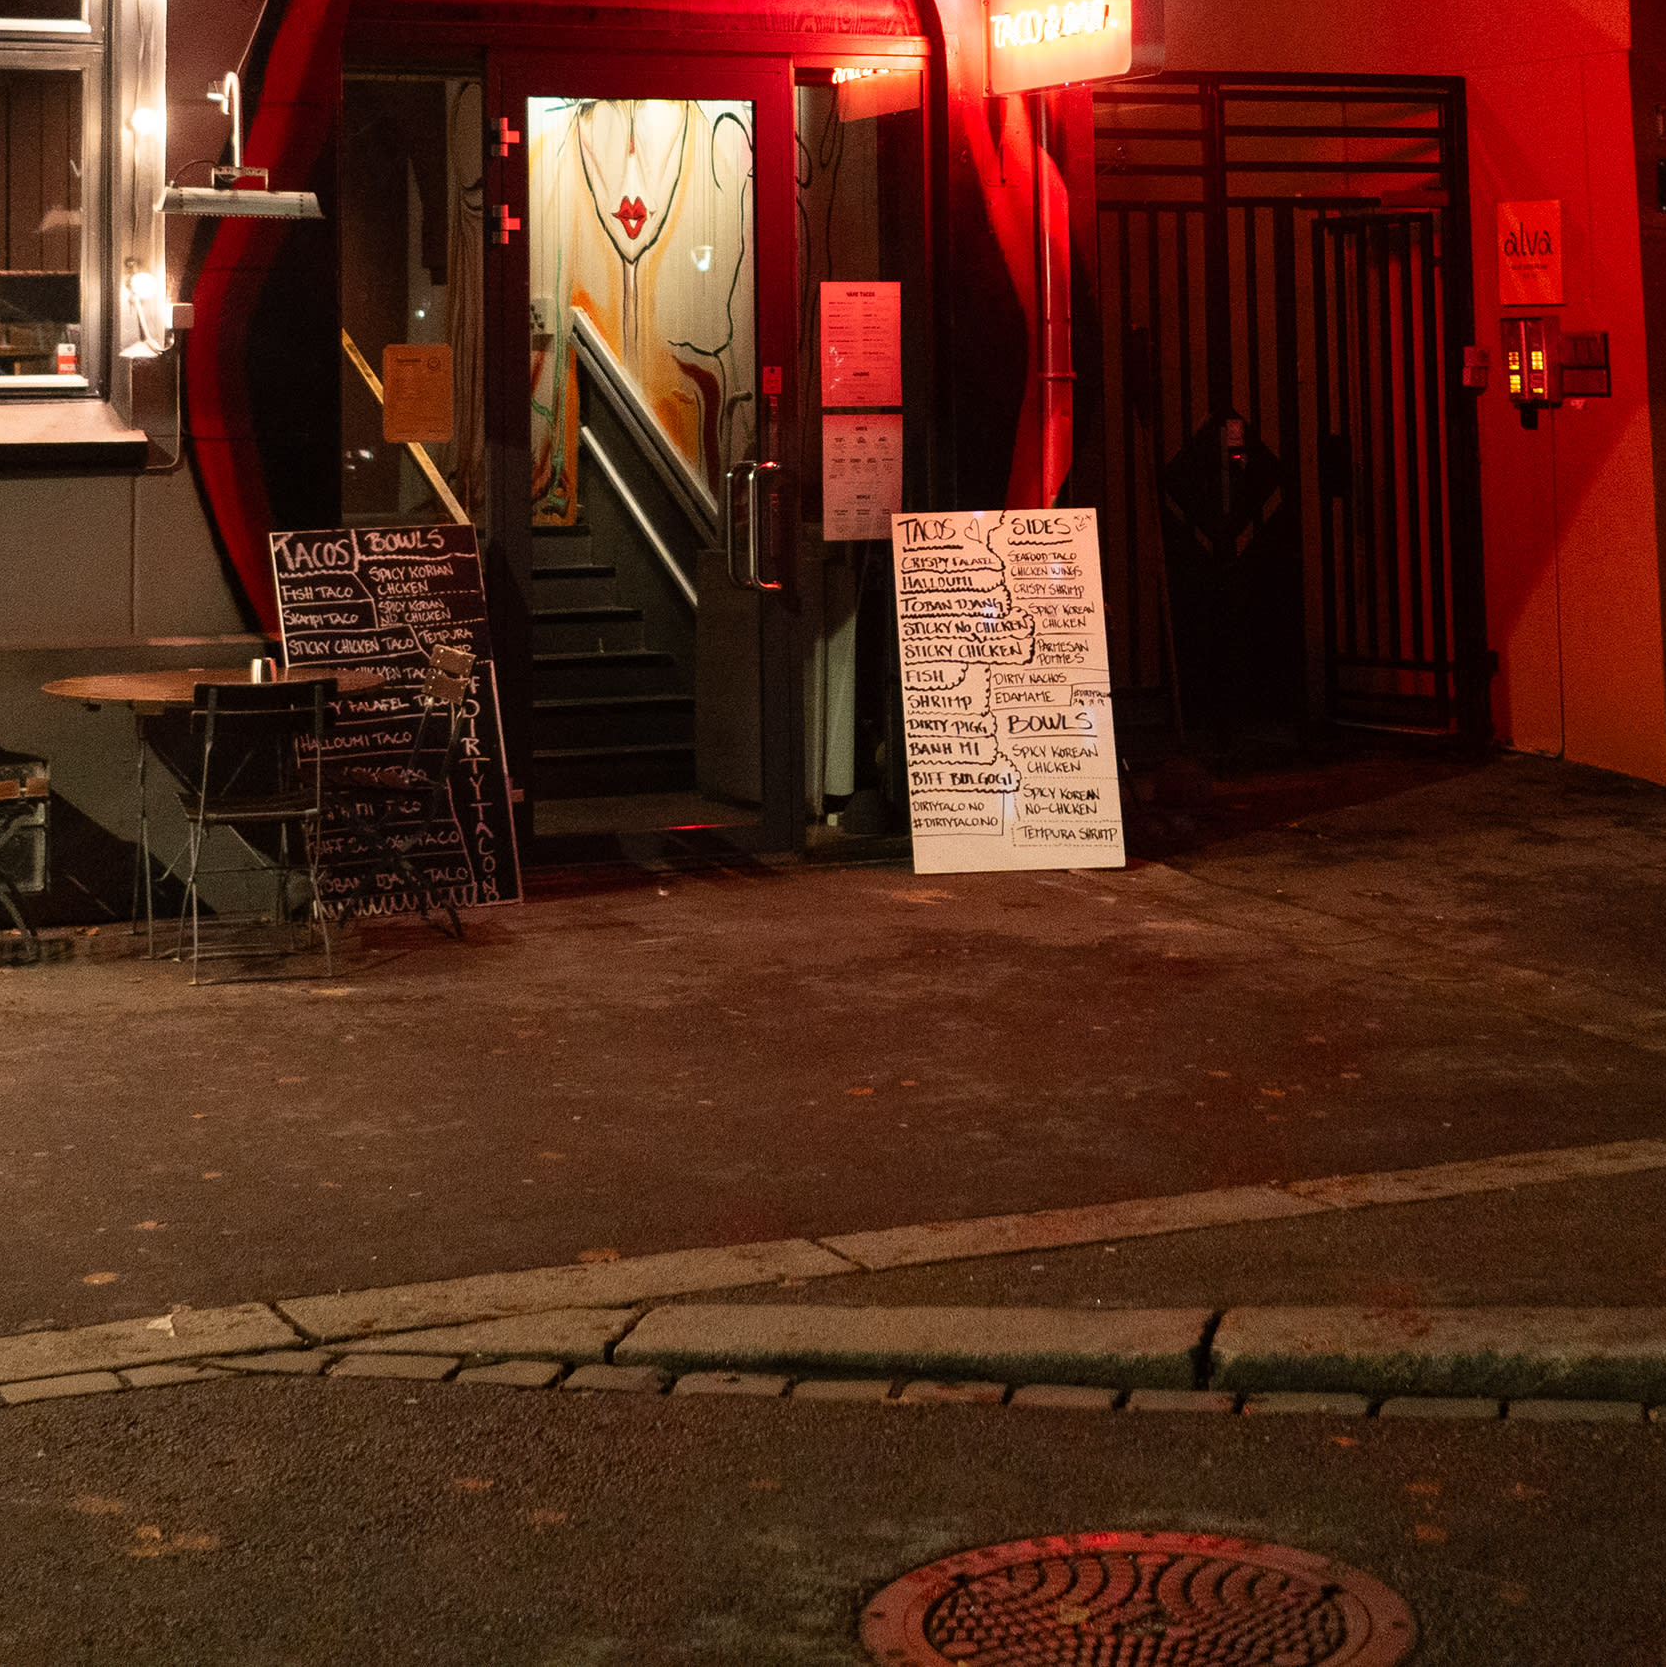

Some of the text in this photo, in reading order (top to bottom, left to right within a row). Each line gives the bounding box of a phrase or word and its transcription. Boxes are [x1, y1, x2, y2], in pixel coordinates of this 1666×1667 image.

[1504, 222, 1554, 256] alva
[897, 517, 956, 545] TACOS
[1011, 516, 1071, 535] SIDES
[364, 529, 446, 552] BOWLS
[272, 533, 352, 571] TACOS
[1008, 550, 1077, 562] SEAFOOD TACO
[901, 557, 949, 569] CRISPY
[1010, 565, 1083, 577] CHICKEN WINGS
[368, 562, 454, 583] SPICY KORIAN
[902, 576, 973, 590] HALLOUMI
[1013, 582, 1085, 598] CRISPY SHRIMP
[281, 584, 354, 601] FISH TACO
[378, 600, 406, 614] SPICY
[900, 596, 1004, 612] TOBAN DJANG
[1029, 601, 1095, 616] SPICY KOREAN
[380, 608, 452, 626] NO CHICKEN
[1041, 615, 1087, 629] CHICKEN
[903, 620, 953, 636] STICKY
[975, 615, 1030, 633] CHICKEN
[419, 628, 474, 645] TEMPURA
[288, 636, 415, 656] STICKY CHICKEN TACO
[904, 641, 1023, 659] STICKY CHICKEN
[1036, 638, 1089, 652] PARMESAN
[906, 669, 945, 683] FISH
[993, 672, 1068, 685] DIRTY NACHOS
[907, 694, 973, 710] SHRIMP
[995, 690, 1056, 704] EDAMAME
[348, 697, 410, 715] FALAFEL
[906, 718, 949, 733] DIRTY
[1007, 711, 1093, 734] BOWLS
[372, 731, 412, 746] TACO
[909, 742, 980, 756] BANH MI
[1012, 743, 1099, 758] SPICY KOREAN
[1027, 760, 1081, 773] CHICKEN
[911, 771, 946, 786] BIFF
[1023, 783, 1101, 801] SPICY KOREAN
[385, 799, 422, 815] TCO
[1025, 801, 1098, 816] NO-CHICKEN
[1016, 825, 1119, 842] TEMPURA SHRIMP
[423, 867, 469, 883] TACO
